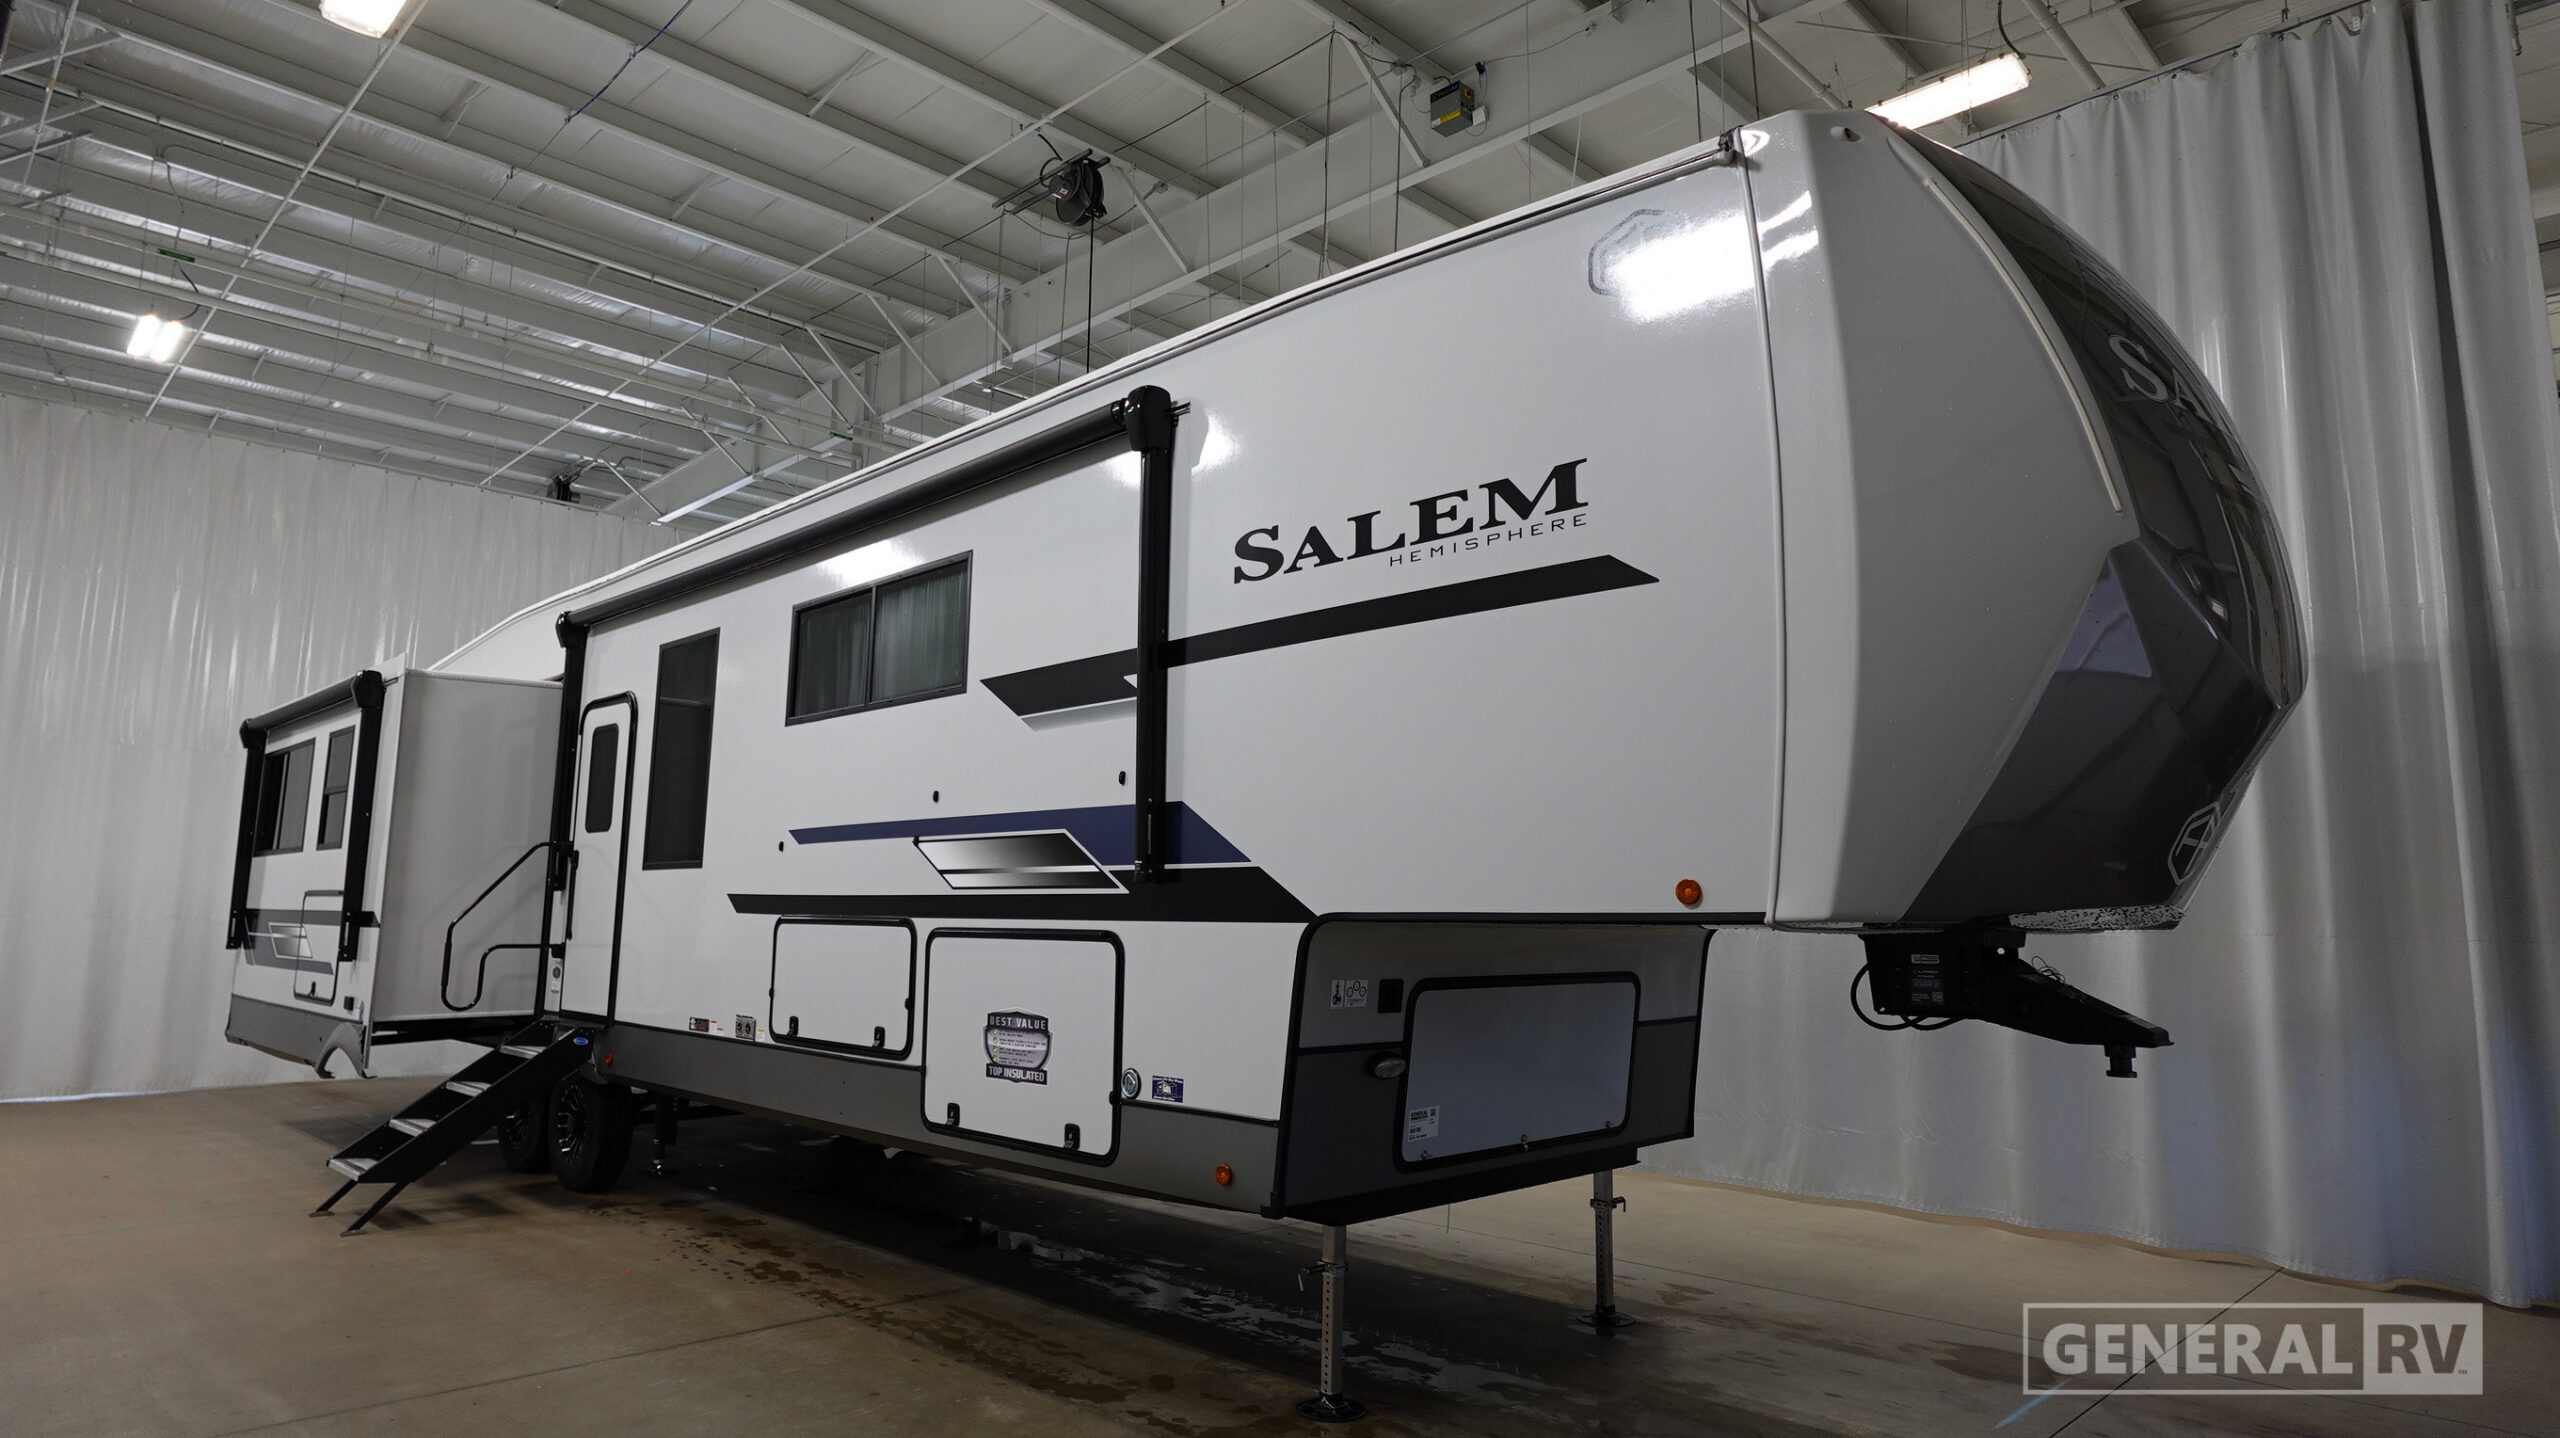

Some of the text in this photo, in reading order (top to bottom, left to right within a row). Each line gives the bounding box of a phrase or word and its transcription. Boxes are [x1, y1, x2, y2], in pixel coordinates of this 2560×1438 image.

[1234, 457, 1589, 584] SALEM
[1389, 513, 1588, 567] HEMISPHERE
[989, 1016, 1047, 1030] BEST VALUE
[988, 1066, 1045, 1082] TOP INSULATED
